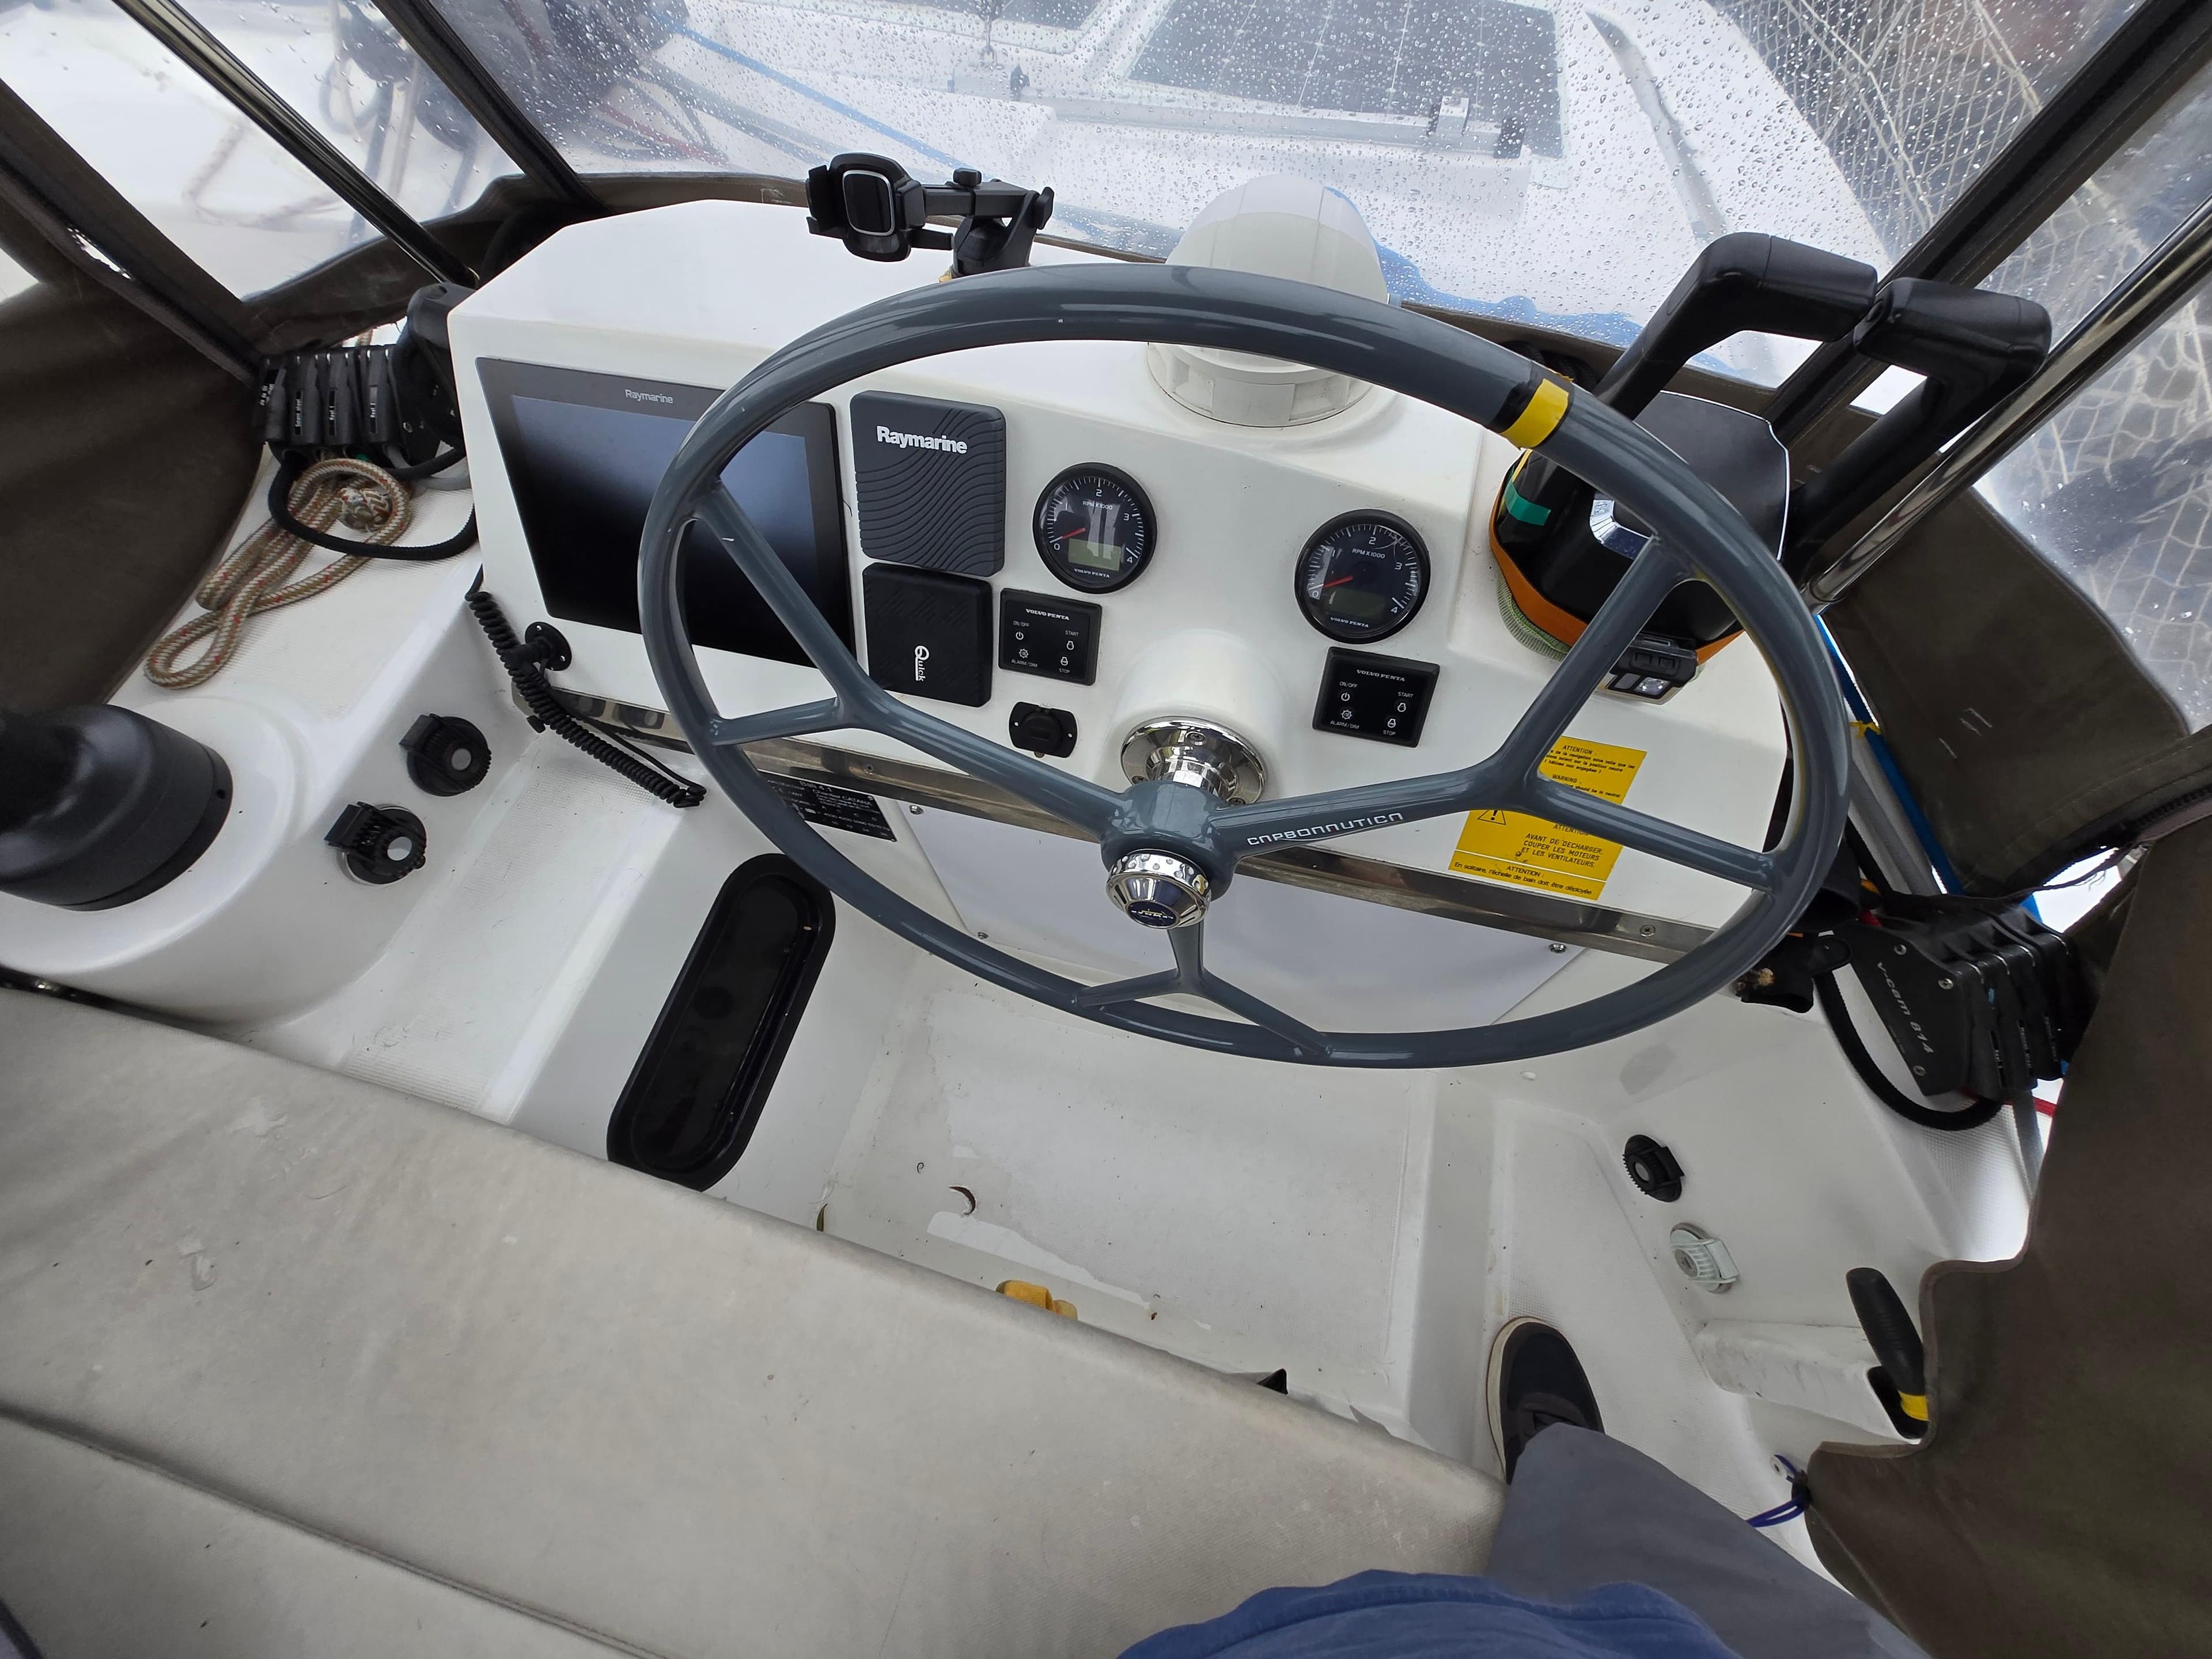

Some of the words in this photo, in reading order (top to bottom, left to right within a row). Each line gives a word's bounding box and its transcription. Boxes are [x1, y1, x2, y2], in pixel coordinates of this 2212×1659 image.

[624, 389, 673, 404] Raymarine
[876, 425, 968, 454] Raymarine
[1065, 502, 1068, 510] 1
[1123, 513, 1130, 521] 3
[1369, 536, 1376, 544] 2
[1395, 562, 1402, 570] 3
[1025, 608, 1047, 616] VOLVO
[1047, 613, 1070, 621] PENTA
[1330, 616, 1349, 624] VOLVO
[914, 645, 930, 681] Quick
[1357, 669, 1380, 677] VOLVO
[1380, 674, 1406, 682] PENTA
[1562, 745, 1593, 755] ATTENTION
[1552, 774, 1578, 783] WARNING
[1525, 833, 1548, 842] AVANT
[1523, 840, 1550, 850] COUPER
[1552, 846, 1566, 854] LES
[1568, 850, 1600, 861] MOTEURS
[1506, 865, 1541, 877] ATTENTION
[1464, 864, 1487, 874] solitaire,
[1522, 876, 1536, 884] bain
[1537, 878, 1550, 887] doit
[1551, 881, 1563, 890] être
[1565, 885, 1593, 896] déployée
[1910, 1021, 1935, 1054] 814
